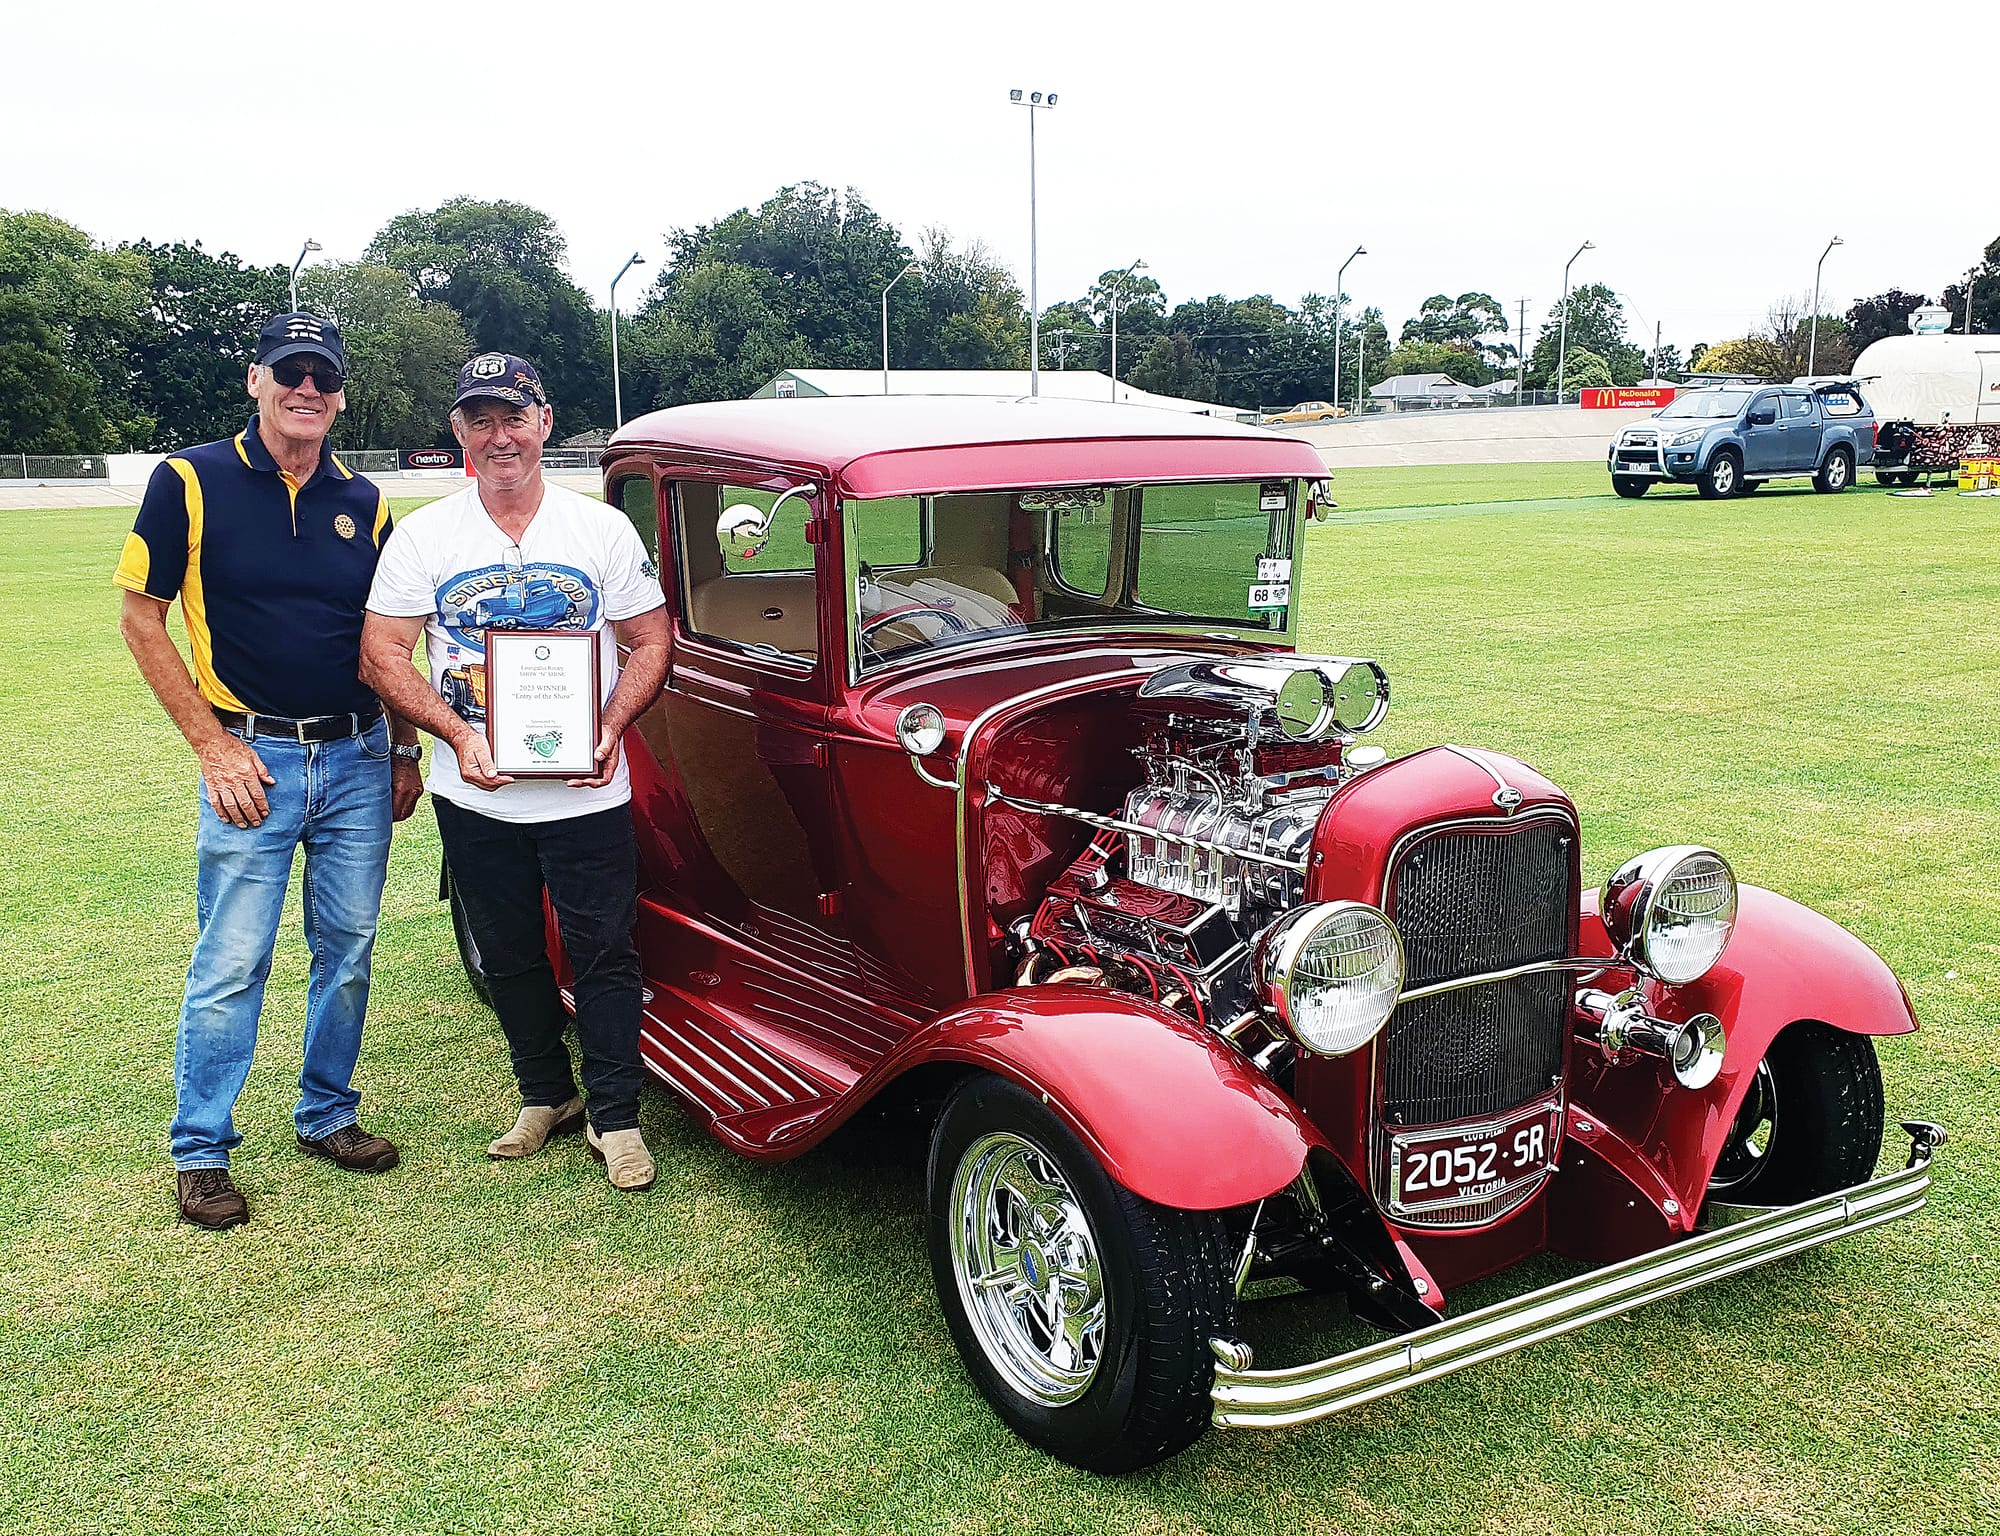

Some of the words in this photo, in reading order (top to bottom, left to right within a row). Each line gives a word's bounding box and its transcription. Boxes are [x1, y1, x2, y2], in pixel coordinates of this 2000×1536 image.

[1618, 399, 1657, 408] Leongatha
[415, 454, 449, 464] nextra
[445, 570, 536, 607] STREET
[545, 571, 588, 604] ROD
[1254, 589, 1269, 602] 68
[536, 684, 567, 692] WINNER
[1458, 1177, 1507, 1197] VICTORIA
